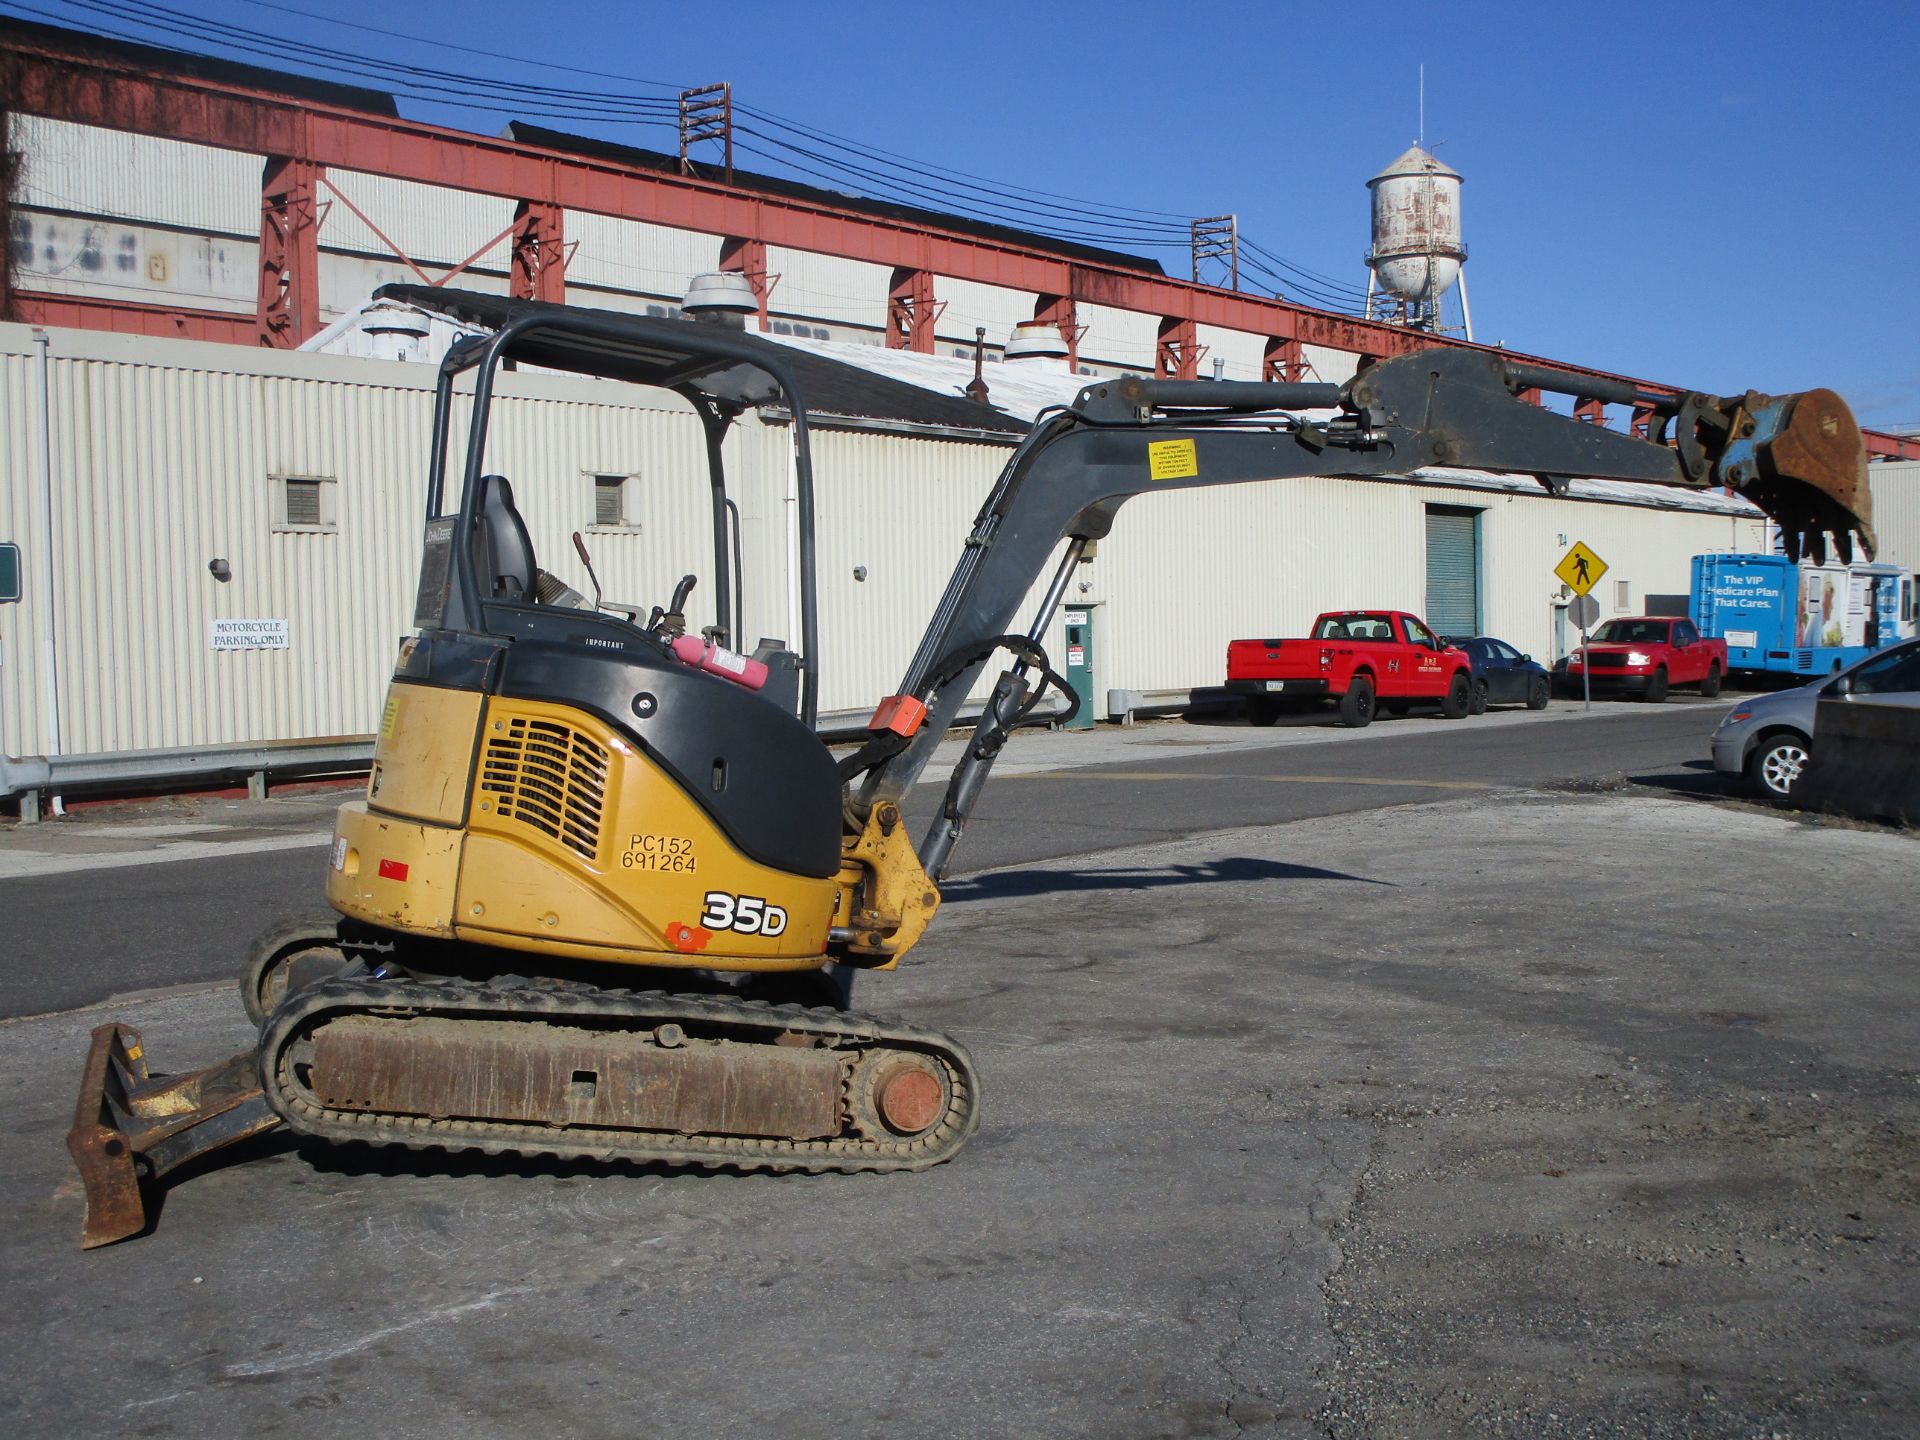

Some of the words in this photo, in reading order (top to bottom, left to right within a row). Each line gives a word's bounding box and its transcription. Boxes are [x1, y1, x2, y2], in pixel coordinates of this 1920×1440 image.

[1724, 575, 1743, 584] The
[1745, 576, 1764, 585] VIP
[1756, 587, 1779, 597] Plan
[1714, 597, 1737, 607] That
[1739, 598, 1772, 608] Cares.
[217, 622, 282, 632] MOTORCYCLE
[214, 635, 257, 646] PARKING
[261, 635, 285, 645] ONLY
[630, 834, 693, 856] PC152
[622, 851, 696, 873] 691264
[700, 890, 789, 938] 35D
